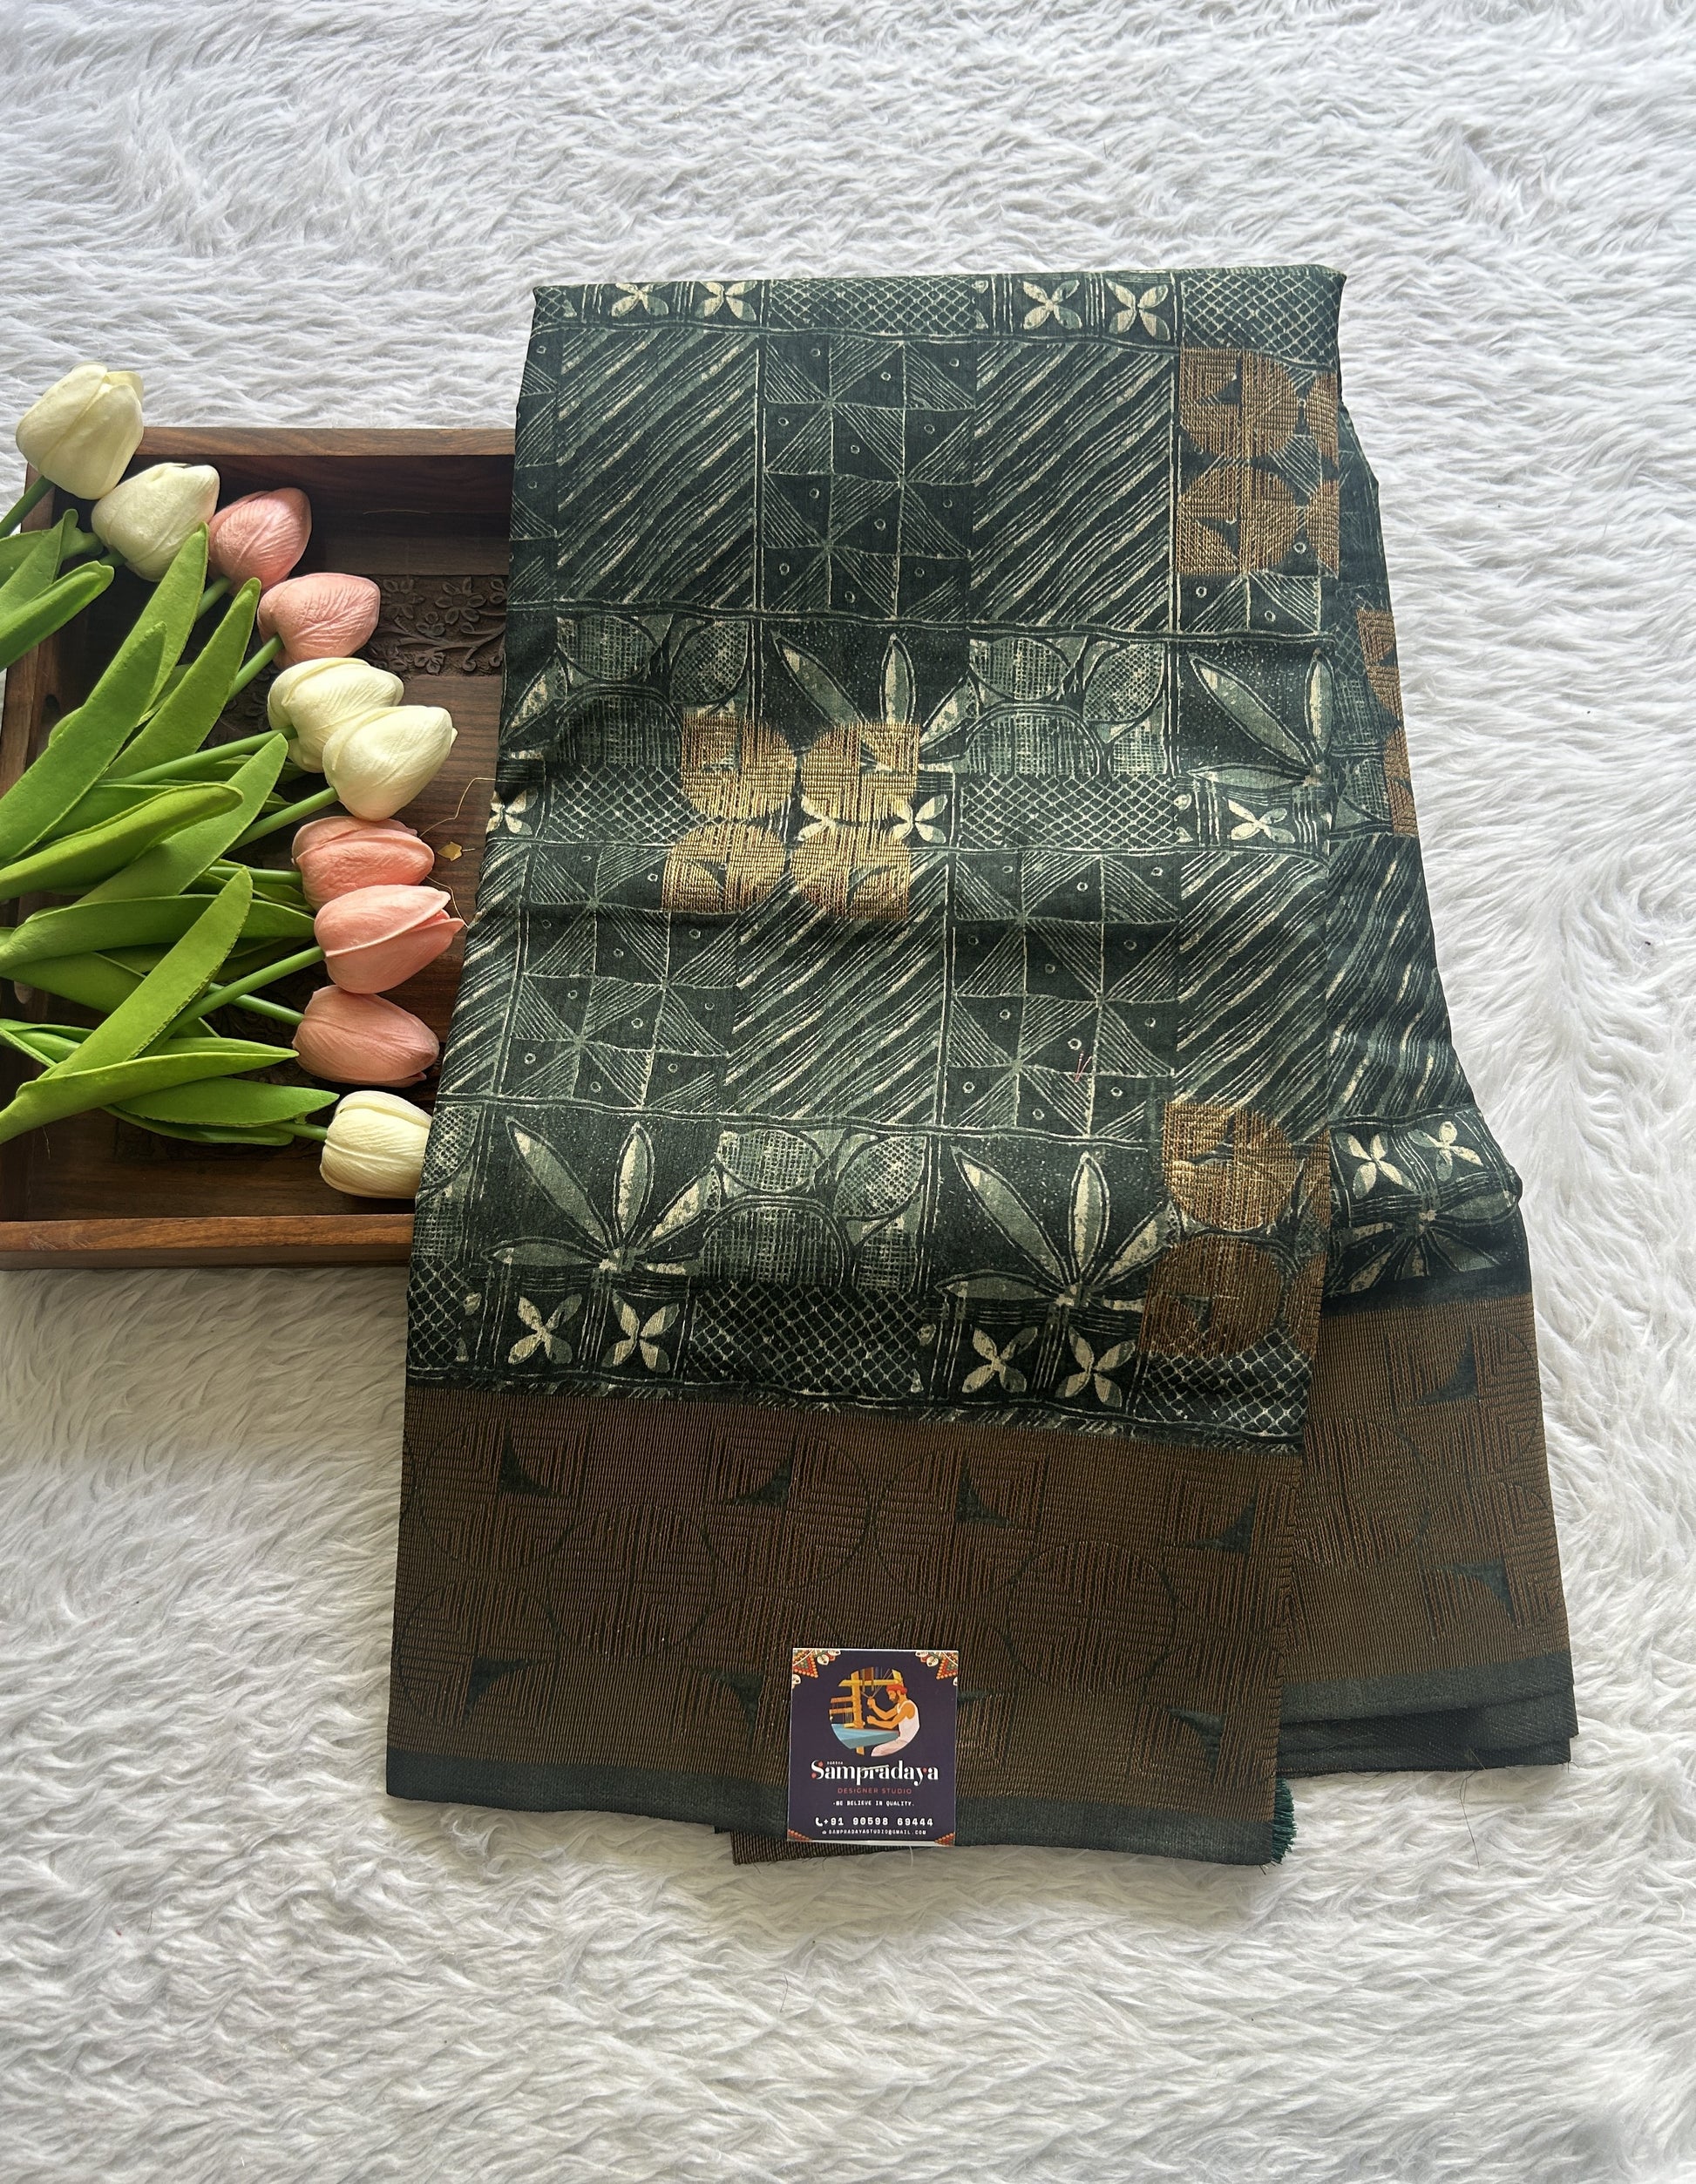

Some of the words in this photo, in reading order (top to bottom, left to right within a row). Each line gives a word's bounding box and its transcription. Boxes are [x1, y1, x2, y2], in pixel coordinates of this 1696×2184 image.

[811, 1760, 939, 1787] Sampradaya
[824, 1816, 845, 1826] +91
[852, 1816, 888, 1826] 90598
[897, 1817, 933, 1827] 69444
